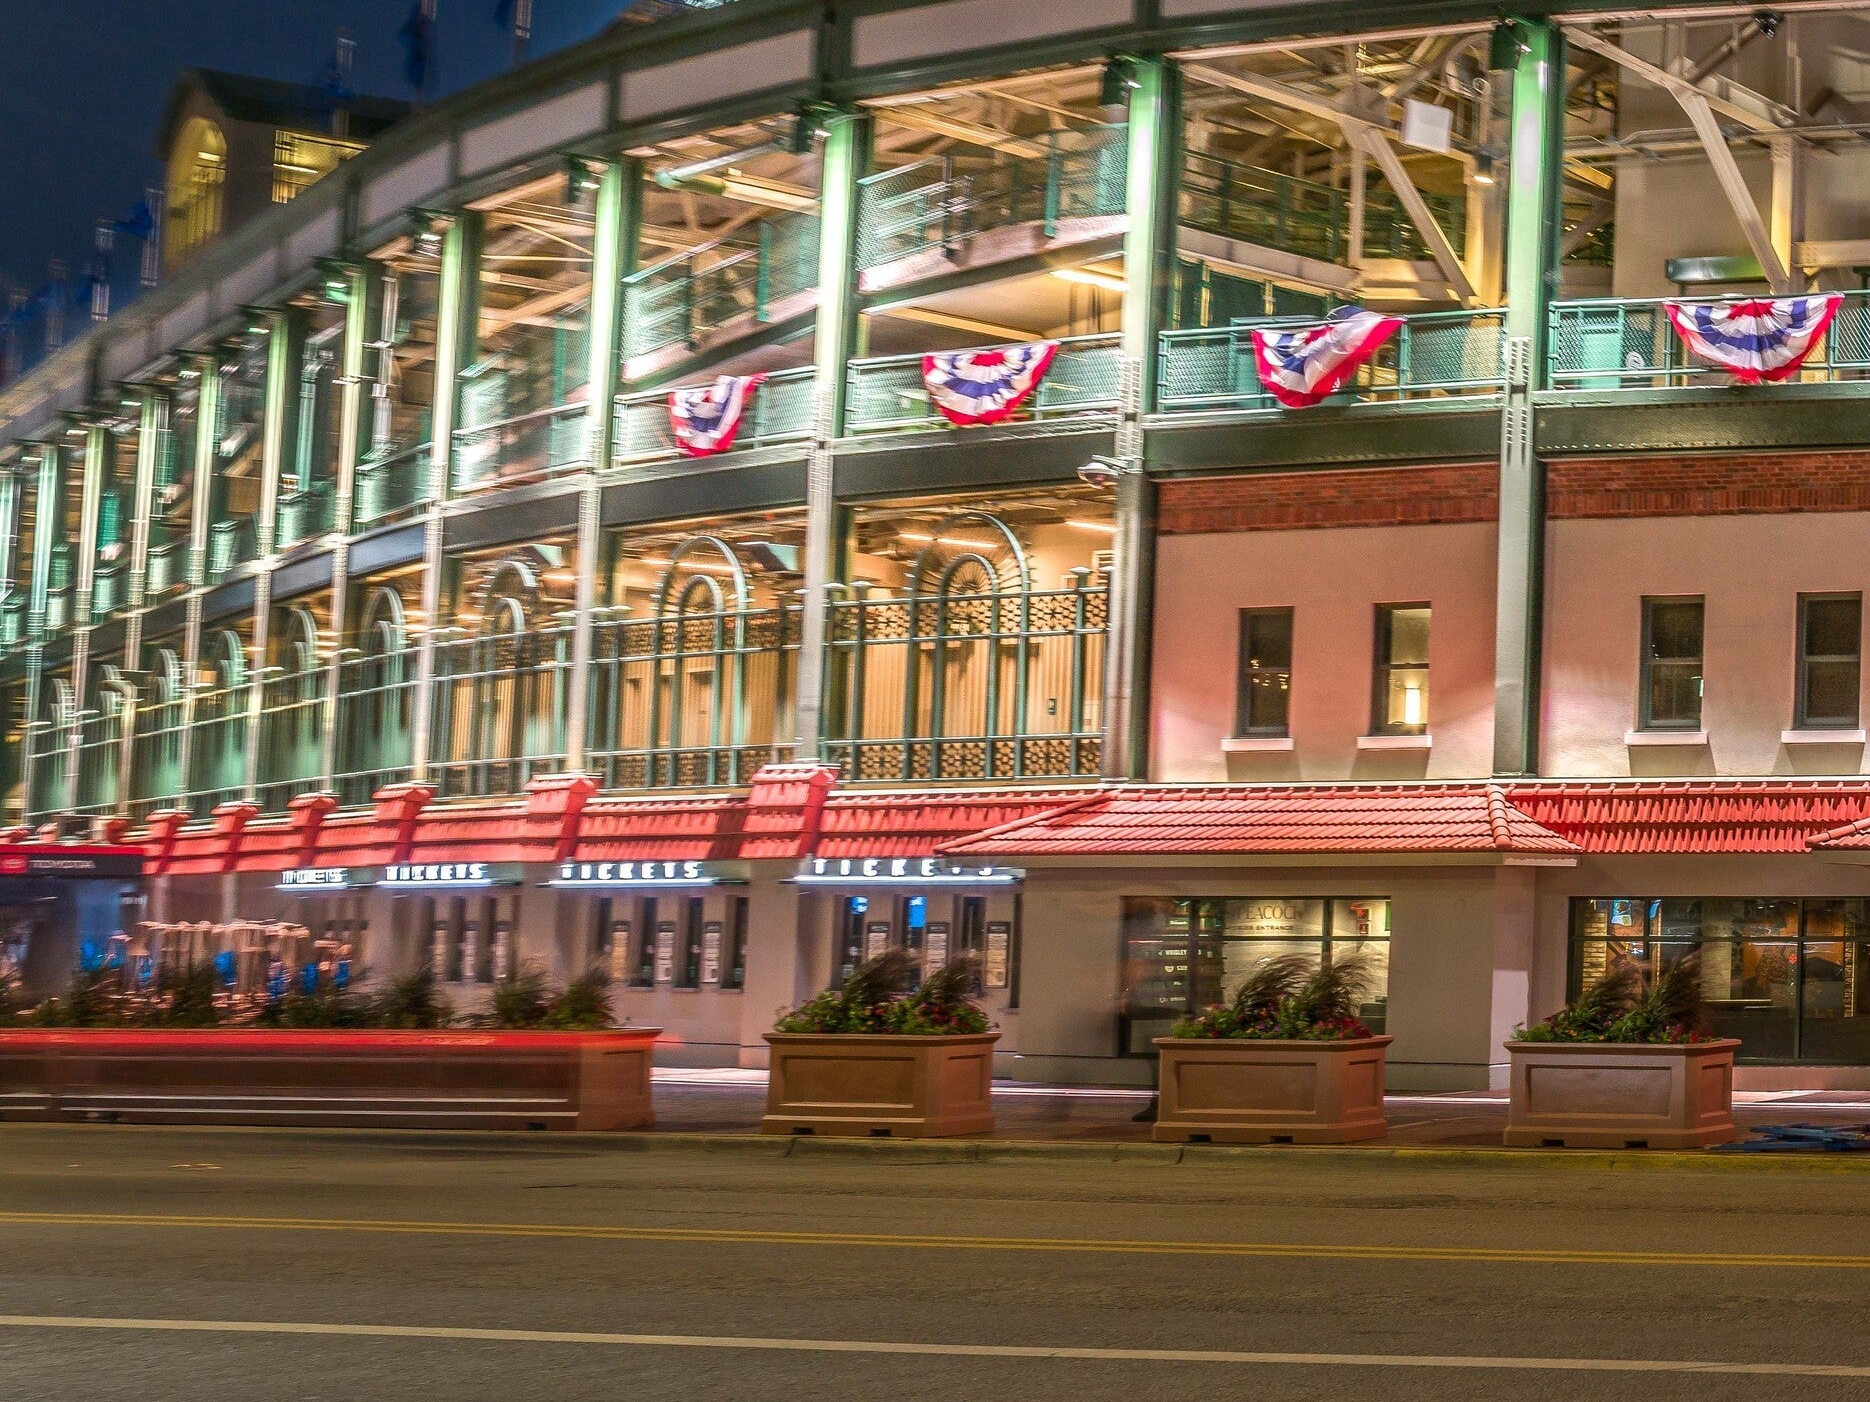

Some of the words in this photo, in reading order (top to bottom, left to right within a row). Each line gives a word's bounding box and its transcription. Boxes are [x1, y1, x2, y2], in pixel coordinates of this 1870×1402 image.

[384, 862, 488, 881] TICKETS
[560, 861, 703, 879] TICKETS
[812, 858, 993, 877] TICKE
